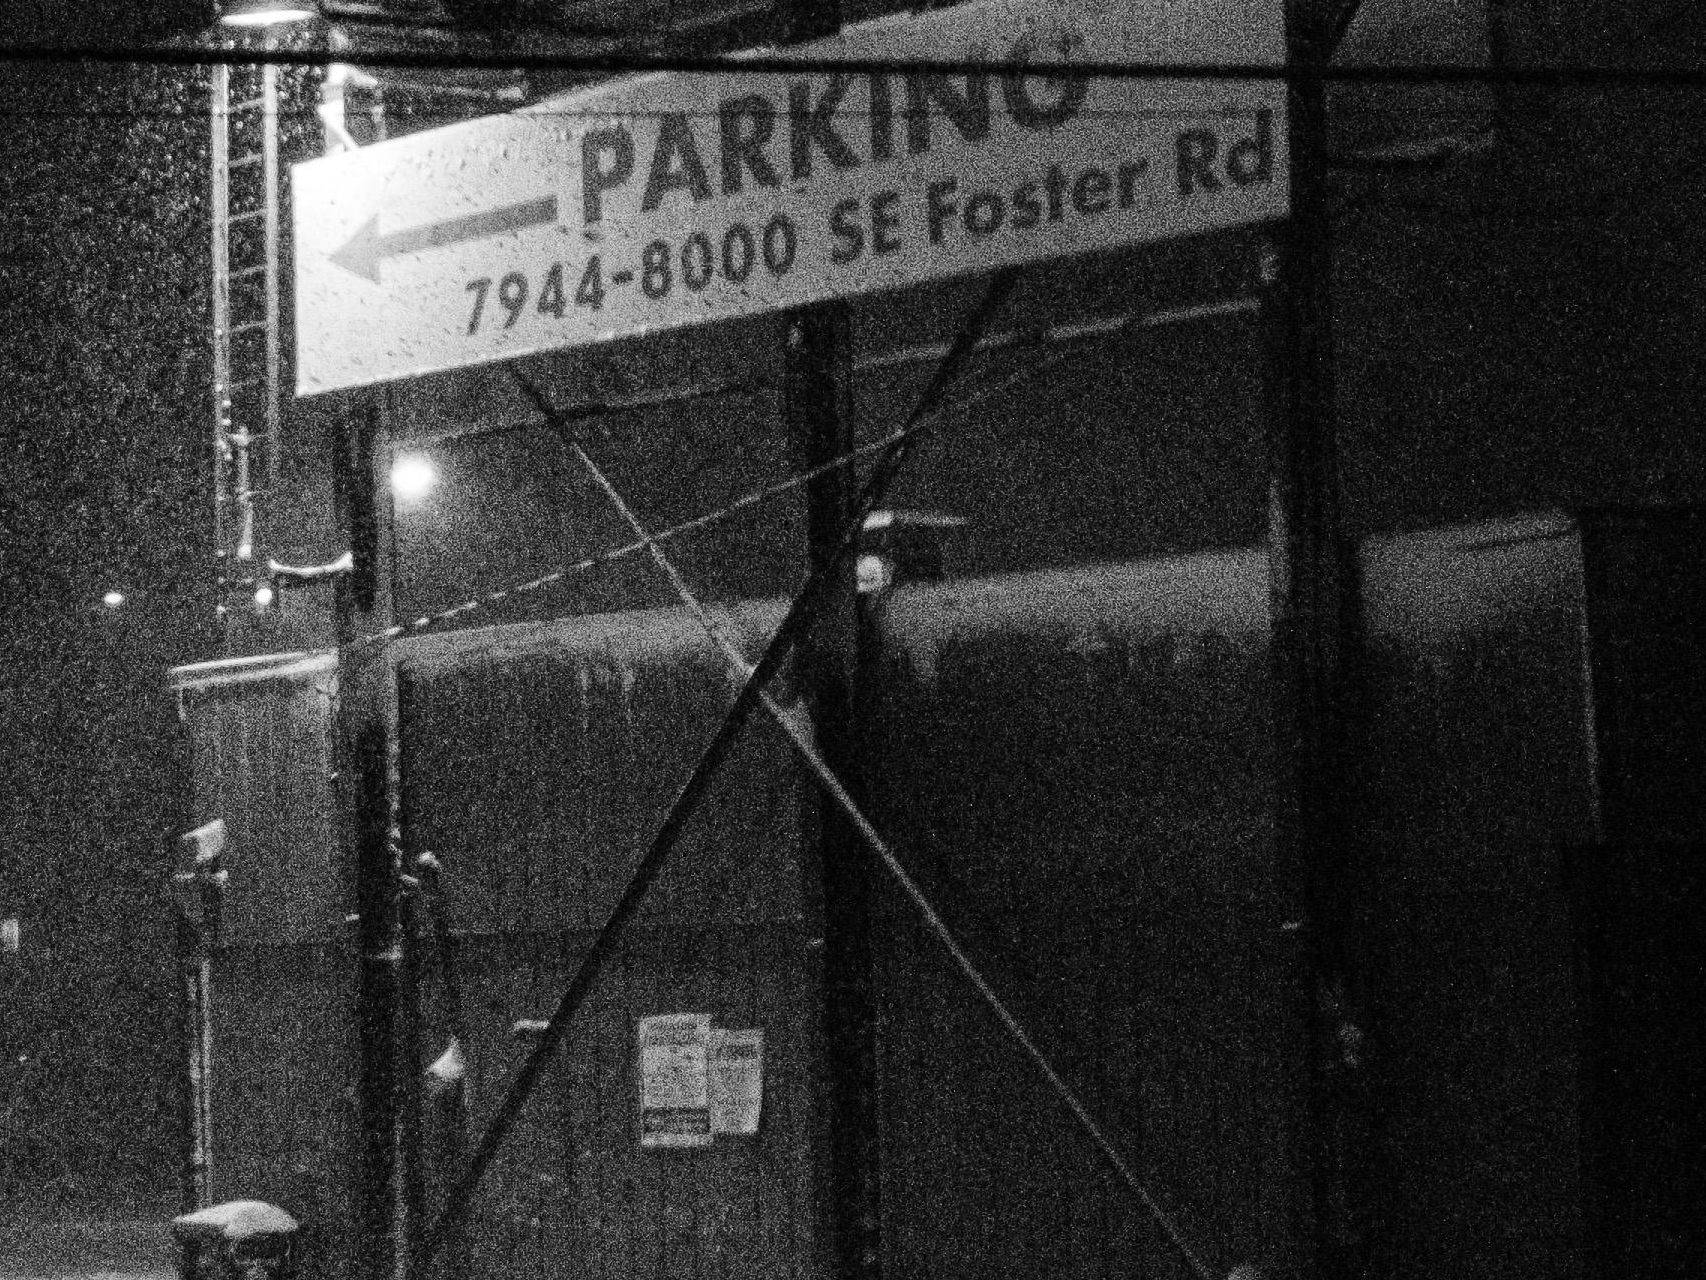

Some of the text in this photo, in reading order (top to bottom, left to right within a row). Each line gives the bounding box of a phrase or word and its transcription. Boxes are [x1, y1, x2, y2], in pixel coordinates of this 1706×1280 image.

[464, 108, 1273, 337] 7944-8000 SE Foster Rd
[580, 29, 1090, 225] PARKING
